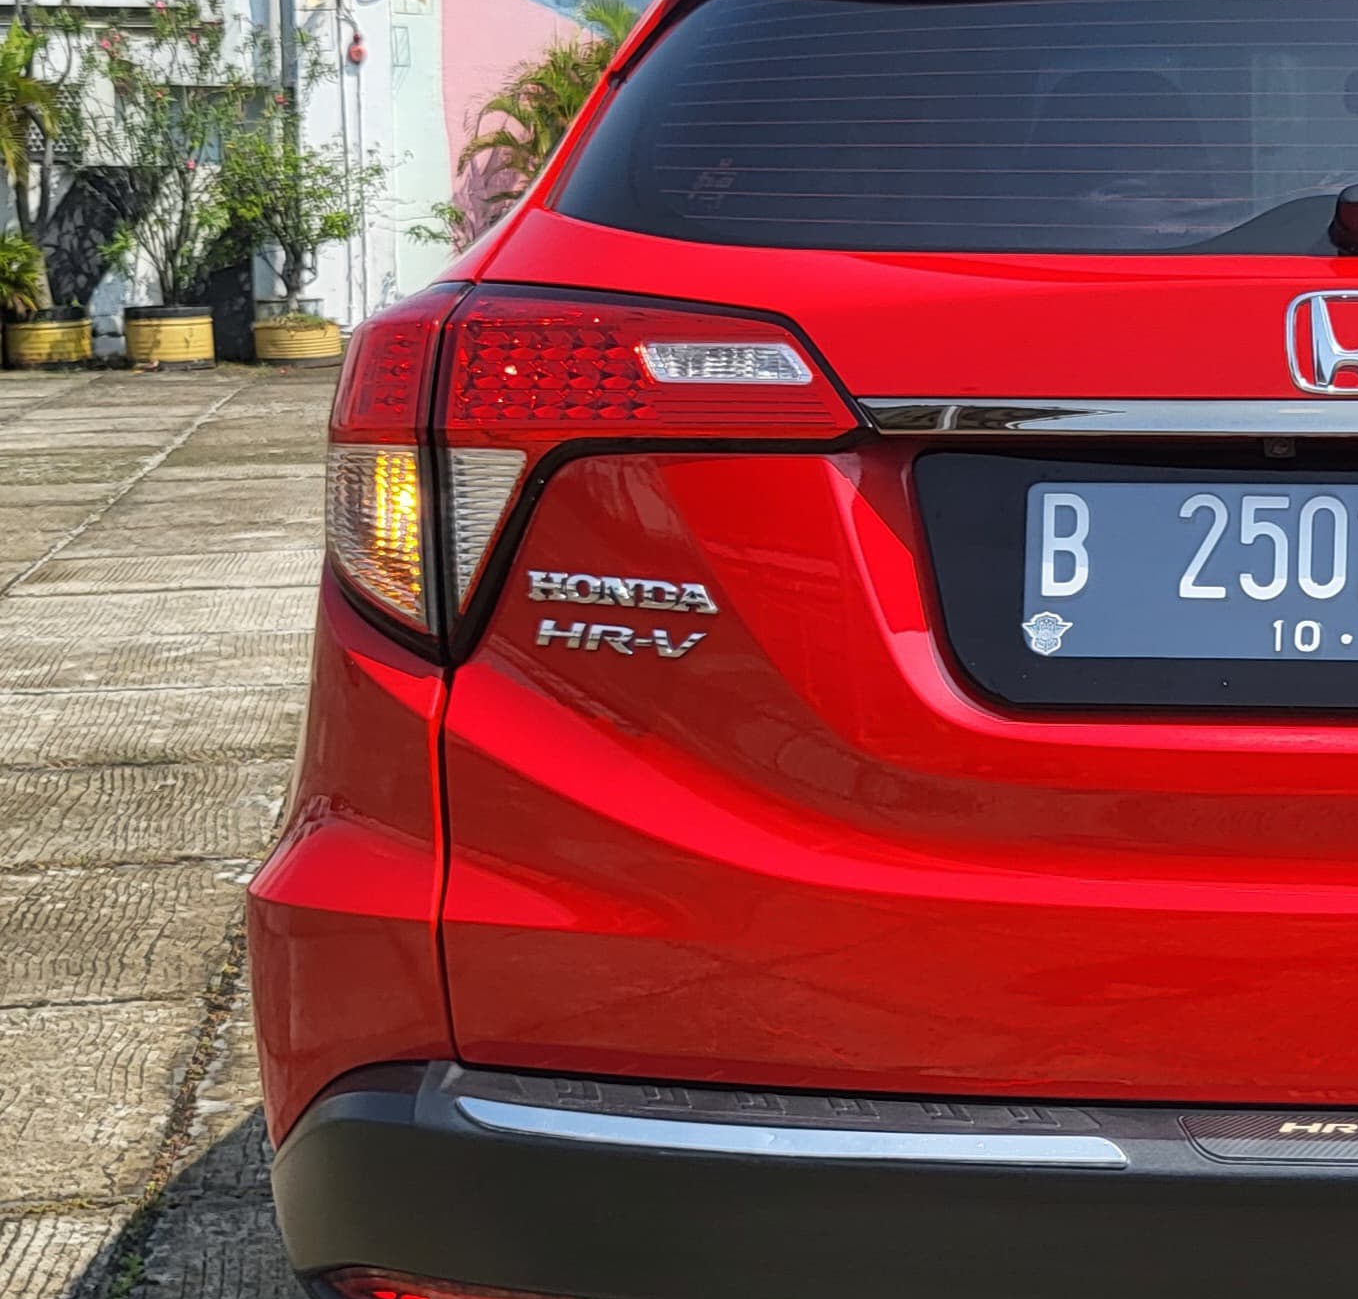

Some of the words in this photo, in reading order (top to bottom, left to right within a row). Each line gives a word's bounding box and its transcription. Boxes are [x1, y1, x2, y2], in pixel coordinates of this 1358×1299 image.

[1040, 493, 1090, 597] B
[528, 570, 719, 614] HONDA
[536, 619, 708, 658] HR-V
